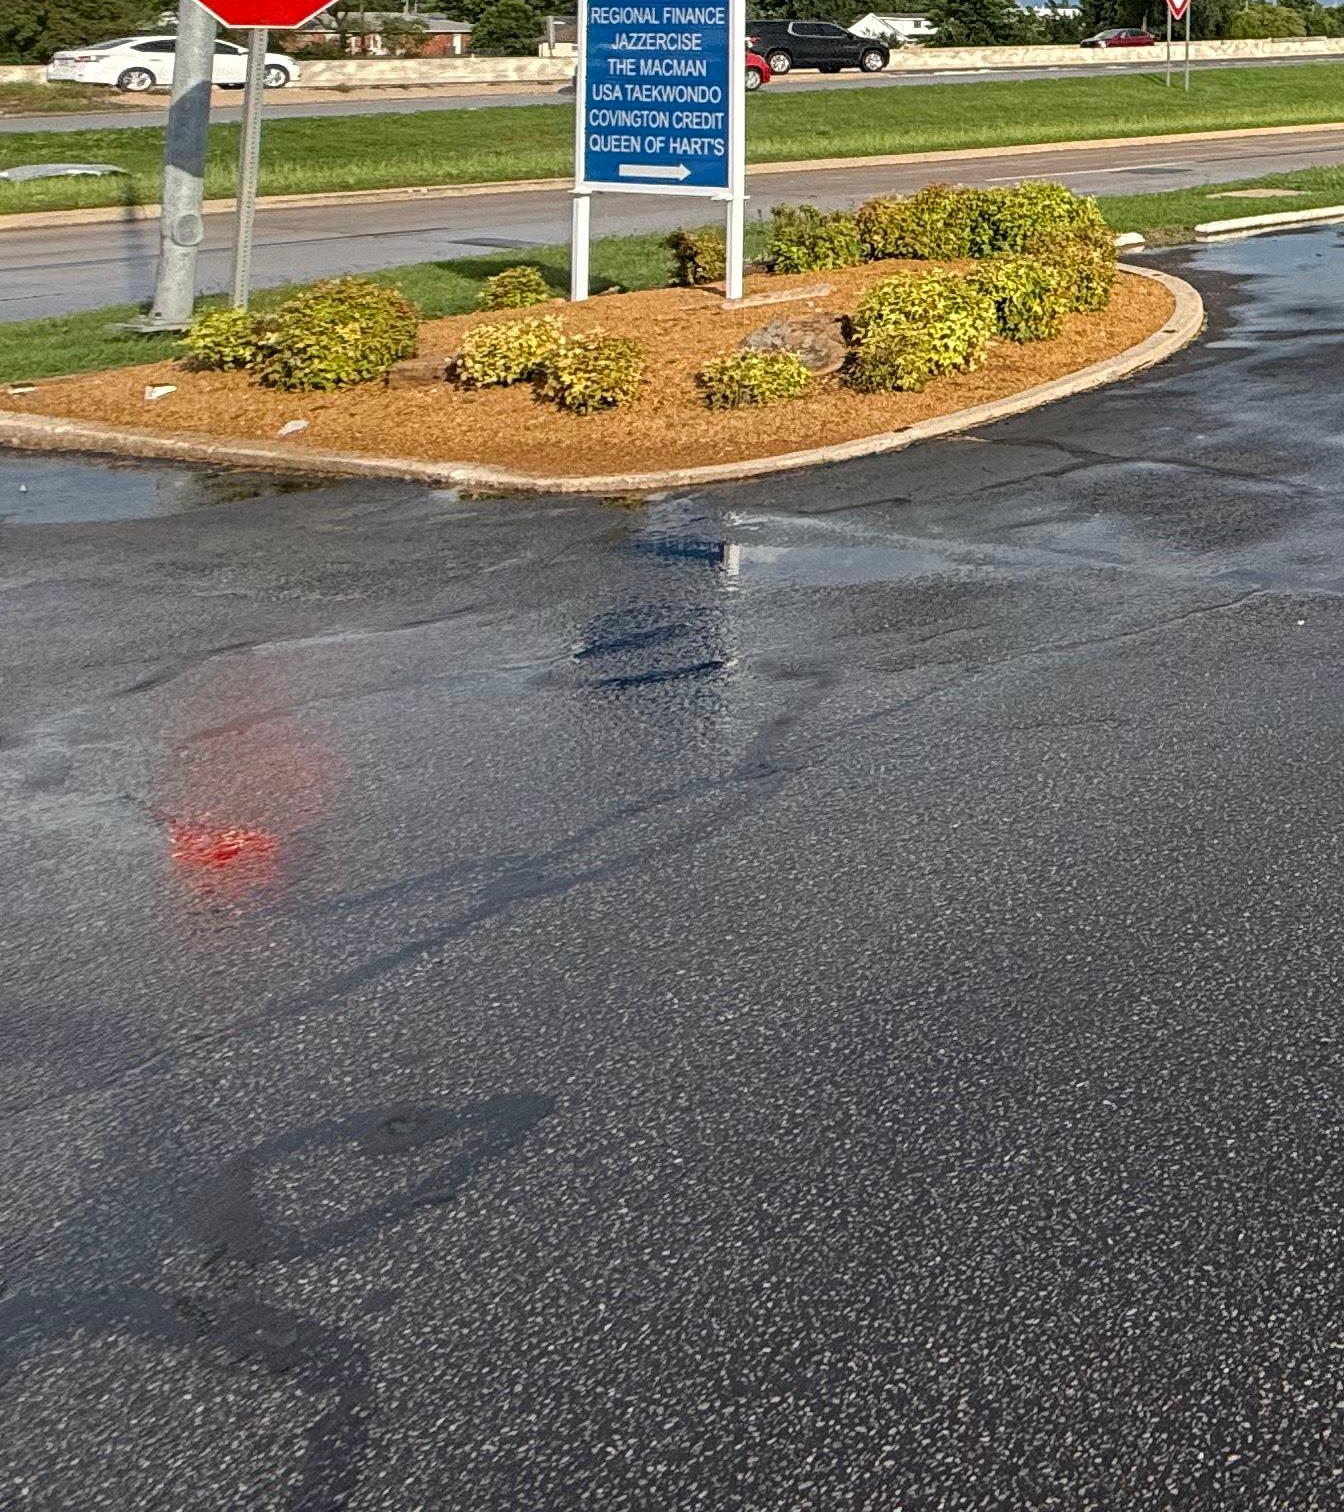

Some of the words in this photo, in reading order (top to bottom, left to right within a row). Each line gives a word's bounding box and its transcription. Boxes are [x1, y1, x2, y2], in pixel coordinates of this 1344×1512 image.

[591, 7, 659, 24] REGIONAL
[663, 7, 726, 25] FINANCE
[612, 32, 702, 50] JAZZERCISE
[607, 58, 636, 76] THE
[640, 59, 707, 77] MACMAN
[592, 84, 623, 101] USA
[624, 84, 722, 104] TAEKWONDO
[589, 109, 670, 128] COVINGTON
[672, 111, 725, 129] CREDIT
[589, 134, 641, 152] QUEEN
[644, 136, 665, 154] OF
[669, 137, 725, 156] HART'S
